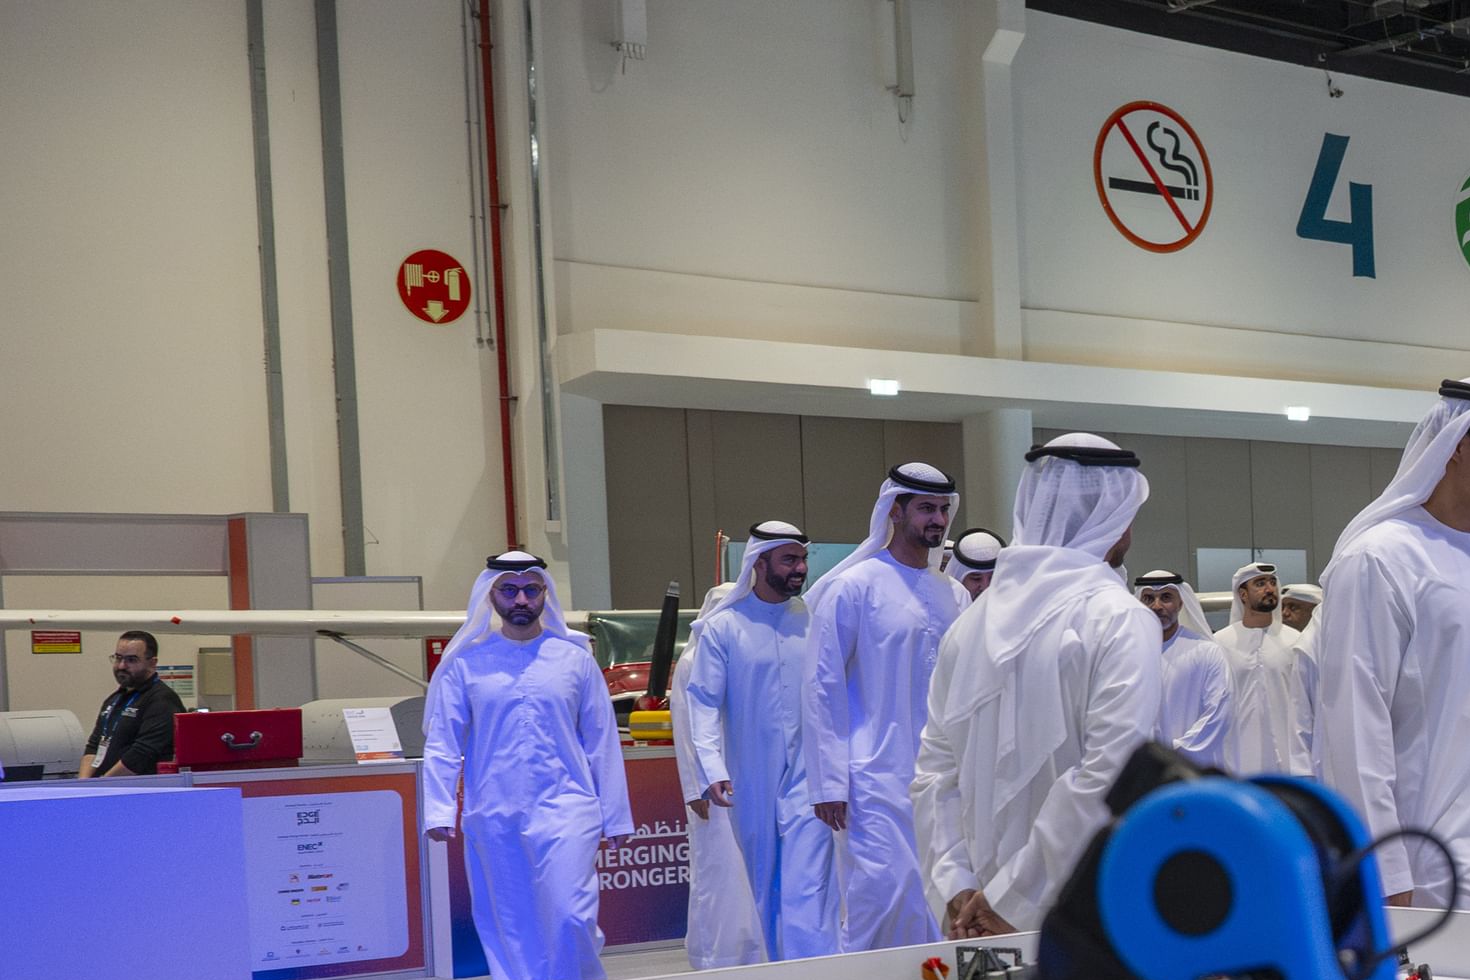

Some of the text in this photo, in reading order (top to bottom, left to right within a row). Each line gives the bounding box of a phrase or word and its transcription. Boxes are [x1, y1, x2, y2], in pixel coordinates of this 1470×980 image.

[1296, 132, 1376, 279] 4
[594, 842, 690, 869] ERGING
[599, 865, 691, 891] RONGER
